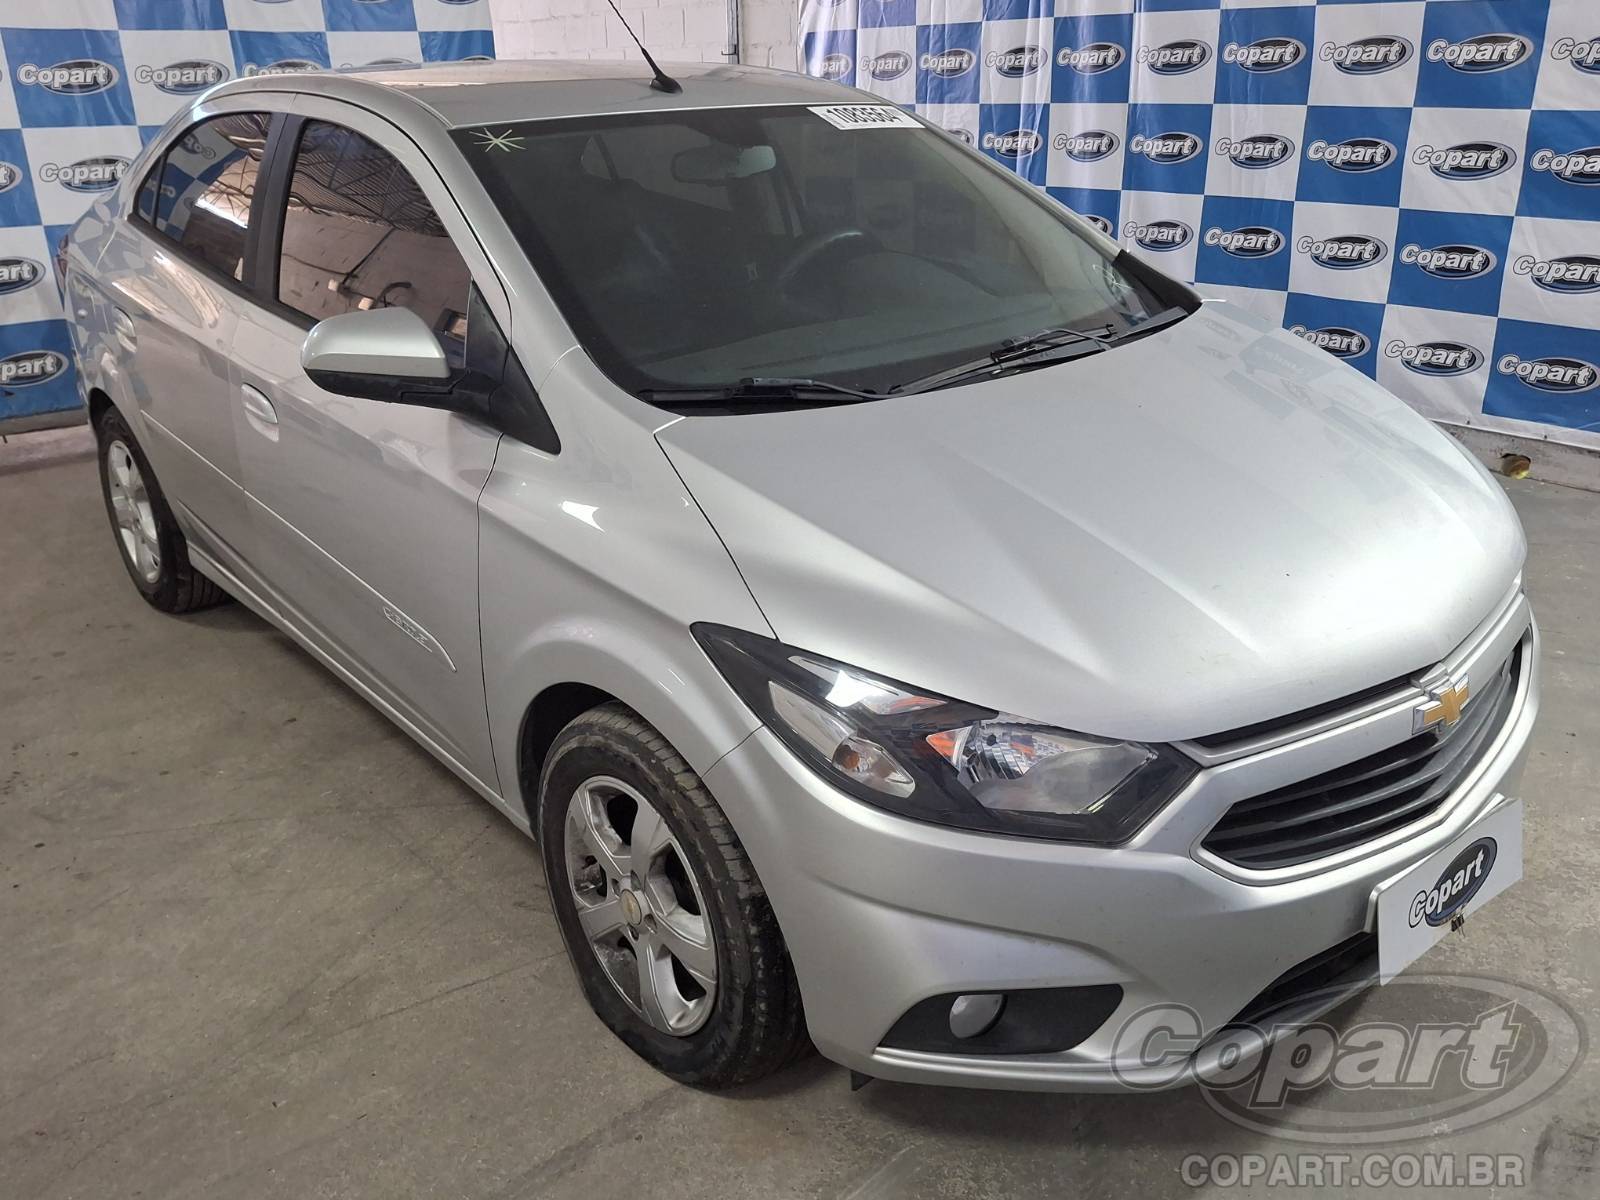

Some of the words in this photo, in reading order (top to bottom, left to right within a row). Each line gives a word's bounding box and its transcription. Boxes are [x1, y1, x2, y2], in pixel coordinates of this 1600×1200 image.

[920, 52, 969, 72] Copart
[986, 50, 1040, 71] Copart
[1057, 46, 1117, 66] Copart
[1137, 44, 1202, 67] Copart
[1223, 42, 1296, 66] Copart
[1319, 41, 1403, 65] Copart
[1427, 38, 1520, 66] Copart
[18, 64, 107, 88] Copart
[135, 64, 217, 88] Copart
[860, 56, 904, 73] Copart
[983, 132, 1037, 154] Copart
[1054, 134, 1110, 152] Copart
[1130, 134, 1194, 155] Copart
[1215, 137, 1285, 160] Copart
[1308, 140, 1387, 164] Copart
[1412, 144, 1504, 171] Copart
[40, 161, 128, 186] Copart
[1123, 221, 1183, 243] Copart
[1205, 227, 1278, 250] Copart
[1298, 236, 1377, 260] Copart
[1400, 244, 1486, 271] Copart
[1385, 340, 1472, 368] Copart
[1498, 355, 1591, 385] Copart
[1408, 848, 1485, 928] Copart
